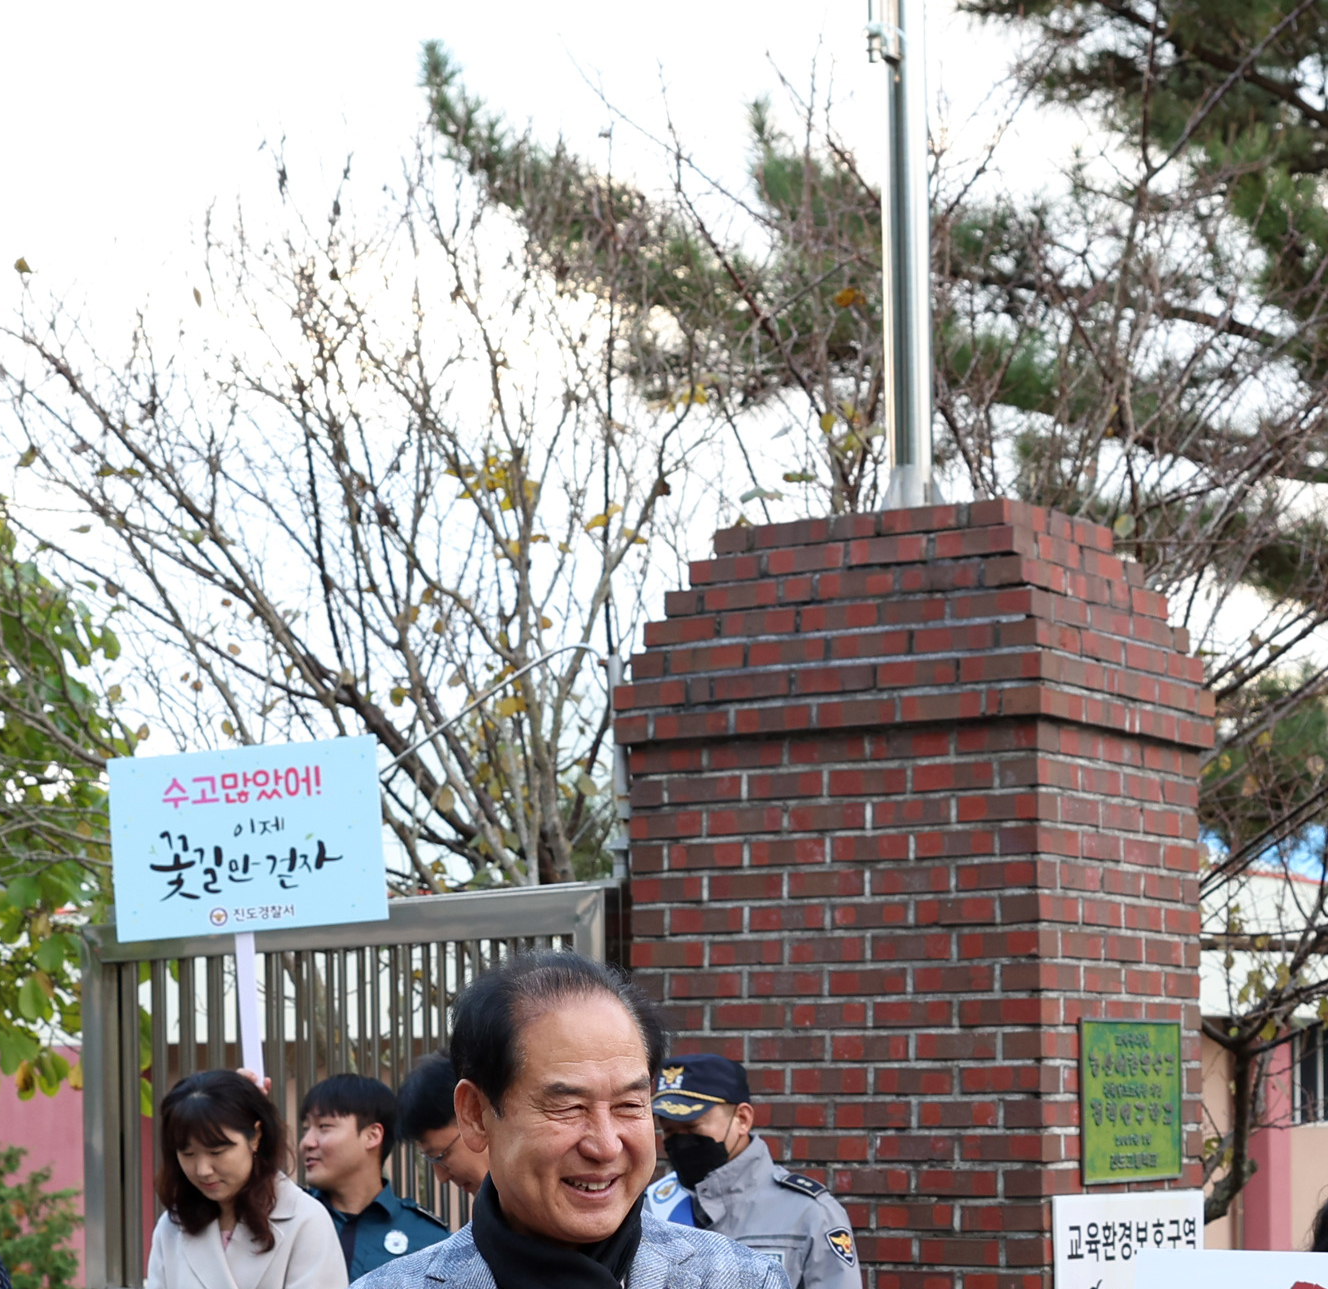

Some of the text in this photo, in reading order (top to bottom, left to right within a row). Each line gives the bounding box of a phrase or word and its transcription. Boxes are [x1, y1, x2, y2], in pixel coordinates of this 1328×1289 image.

[162, 765, 322, 808] 수고많았어!
[233, 817, 285, 837] 이제
[232, 904, 295, 922] 진도경찰서
